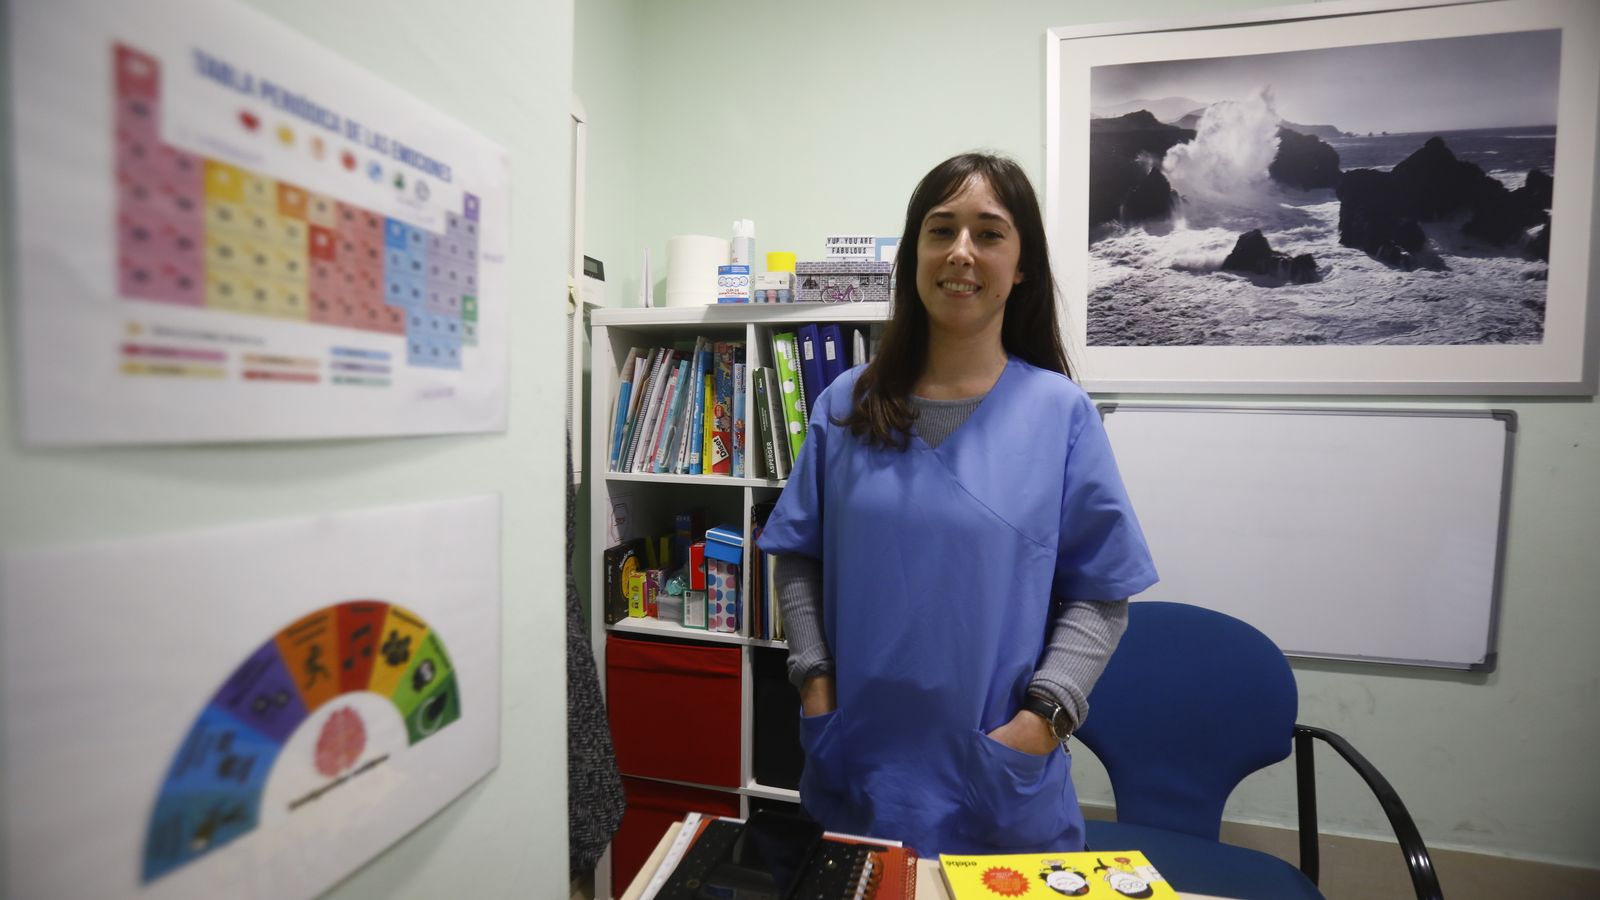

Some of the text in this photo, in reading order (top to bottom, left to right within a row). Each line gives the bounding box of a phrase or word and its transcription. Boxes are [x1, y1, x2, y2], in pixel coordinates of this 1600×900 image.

[345, 117, 361, 143] DE
[365, 126, 389, 154] LAS
[391, 139, 453, 184] EMOCIONES
[713, 437, 727, 458] Diset
[766, 441, 775, 474] ASPERGER
